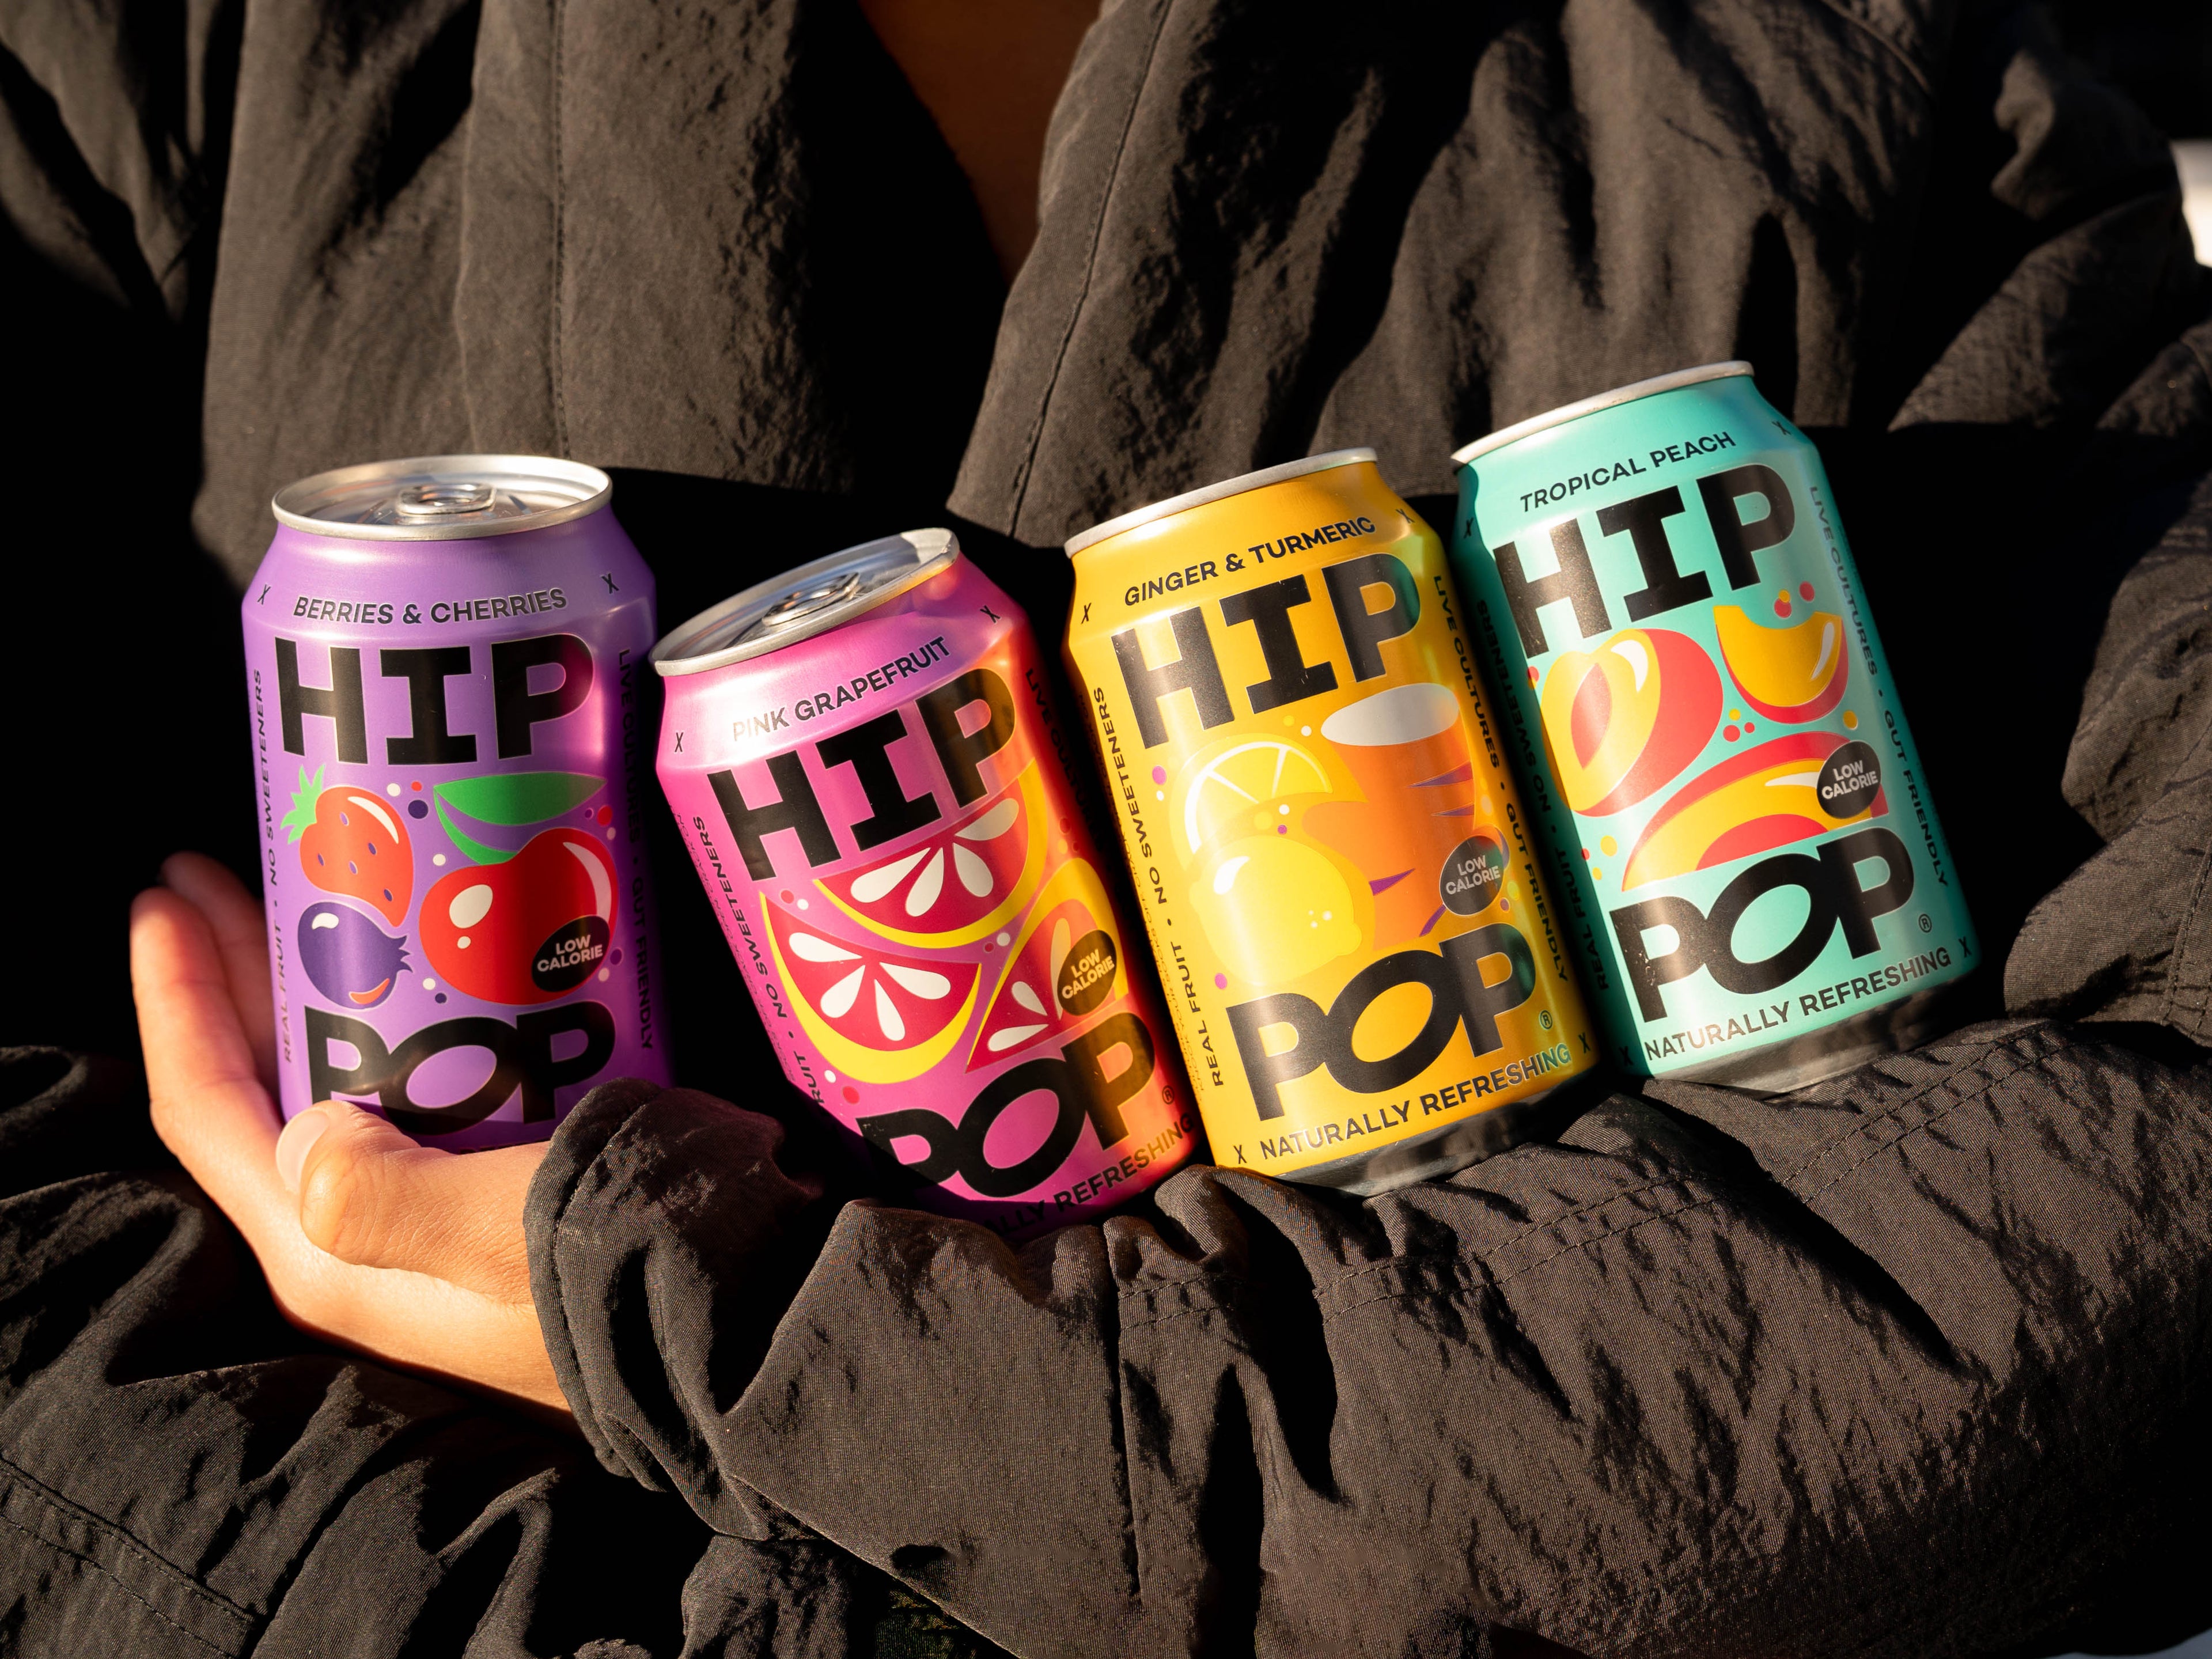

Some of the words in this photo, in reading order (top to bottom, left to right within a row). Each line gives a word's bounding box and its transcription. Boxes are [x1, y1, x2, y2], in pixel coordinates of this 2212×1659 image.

[1520, 458, 1647, 513] TROPICAL
[1649, 431, 1737, 468] PEACH
[1124, 560, 1219, 606] GINGER
[1225, 553, 1246, 573] &
[1248, 516, 1377, 564] TURMERIC
[1493, 463, 1796, 659] HIP
[293, 596, 394, 624] BERRIES
[402, 604, 422, 624] &
[430, 588, 567, 623] CHERRIES
[619, 649, 632, 707] LIVE
[732, 706, 790, 742] PINK
[794, 636, 950, 721] GRAPEFRUIT
[1111, 553, 1421, 749] HIP
[1476, 599, 1537, 767] SWEETENERS
[1810, 486, 1834, 541] LIVE
[1831, 547, 1878, 676] CULTURES
[1884, 710, 1908, 762] GUT
[1903, 769, 1948, 887] FRIENDLY
[275, 633, 594, 766] HIP
[254, 669, 274, 840] SWEETENERS
[623, 713, 641, 844] CULTURES
[706, 668, 1016, 881] HIP
[1093, 687, 1153, 858] SWEETENERS
[1434, 575, 1457, 632] LIVE
[1454, 637, 1500, 768] CULTURES
[1506, 802, 1529, 857] GUT
[1524, 862, 1568, 982] FRIENDLY
[1532, 774, 1552, 813] NO
[1821, 771, 1878, 800] CALORIE
[1832, 760, 1863, 781] LOW
[268, 849, 278, 885] NO
[632, 877, 646, 928] GUT
[693, 816, 768, 976] SWEETENERS
[1149, 866, 1168, 904] NO
[1445, 865, 1501, 895] CALORIE
[1457, 855, 1486, 876] LOW
[1555, 847, 1587, 919] FRUIT
[274, 919, 287, 993] FRUIT
[537, 944, 603, 972] CALORIE
[556, 934, 591, 955] LOW
[1070, 949, 1100, 978] LOW
[1582, 924, 1609, 990] REAL
[1609, 827, 1915, 1023] POP
[635, 935, 653, 1050] FRIENDLY
[766, 983, 788, 1018] NO
[1061, 955, 1115, 999] CALORIE
[1171, 941, 1201, 1013] FRUIT
[1643, 1001, 1790, 1062] NATURALLY
[1798, 946, 1952, 1016] REFRESHING
[280, 1005, 291, 1063] REAL
[1198, 1020, 1224, 1086] REAL
[1225, 922, 1536, 1122] POP
[304, 1000, 616, 1136] POP
[793, 1050, 825, 1105] RUIT
[855, 1012, 1156, 1198] POP
[1259, 1099, 1411, 1160] NATURALLY
[1419, 1043, 1571, 1116] REFRESHING
[1054, 1113, 1194, 1212] REFRESHING
